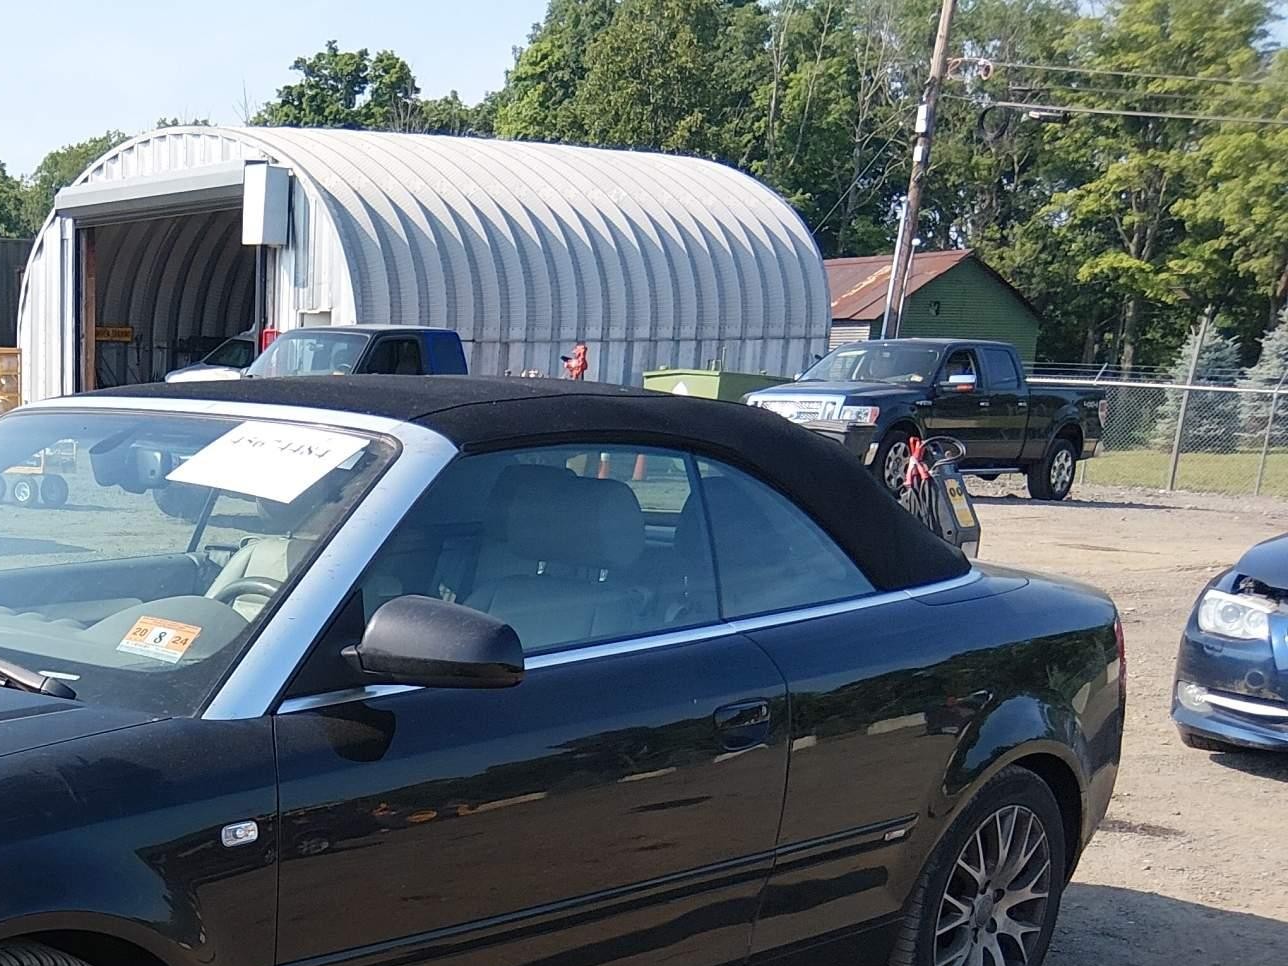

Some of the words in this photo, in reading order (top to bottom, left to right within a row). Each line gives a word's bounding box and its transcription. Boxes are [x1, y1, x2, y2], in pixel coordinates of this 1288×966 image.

[132, 627, 149, 637] 20
[153, 631, 167, 644] 8
[172, 635, 189, 646] 24
